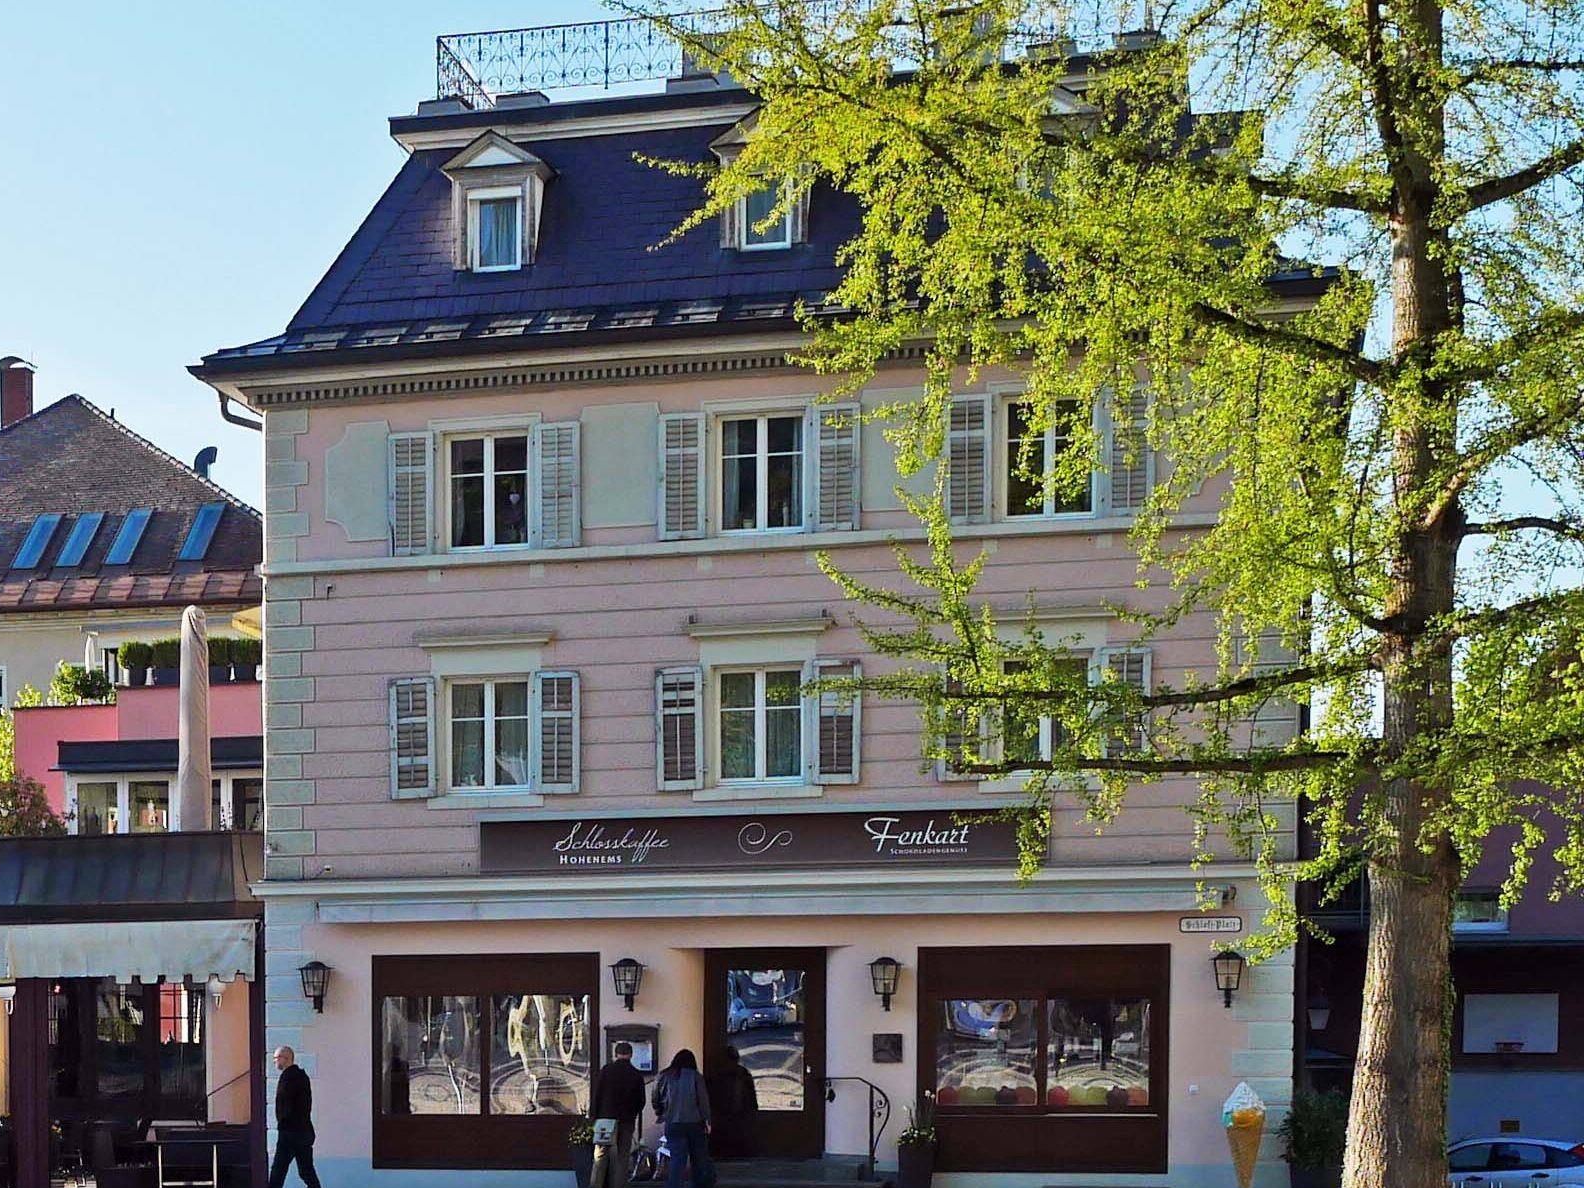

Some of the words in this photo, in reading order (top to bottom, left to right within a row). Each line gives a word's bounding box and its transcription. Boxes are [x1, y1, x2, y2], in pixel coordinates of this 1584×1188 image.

[552, 822, 671, 863] Schlosskaffee
[864, 817, 969, 852] Fenkart
[559, 854, 622, 865] HOHENEMS
